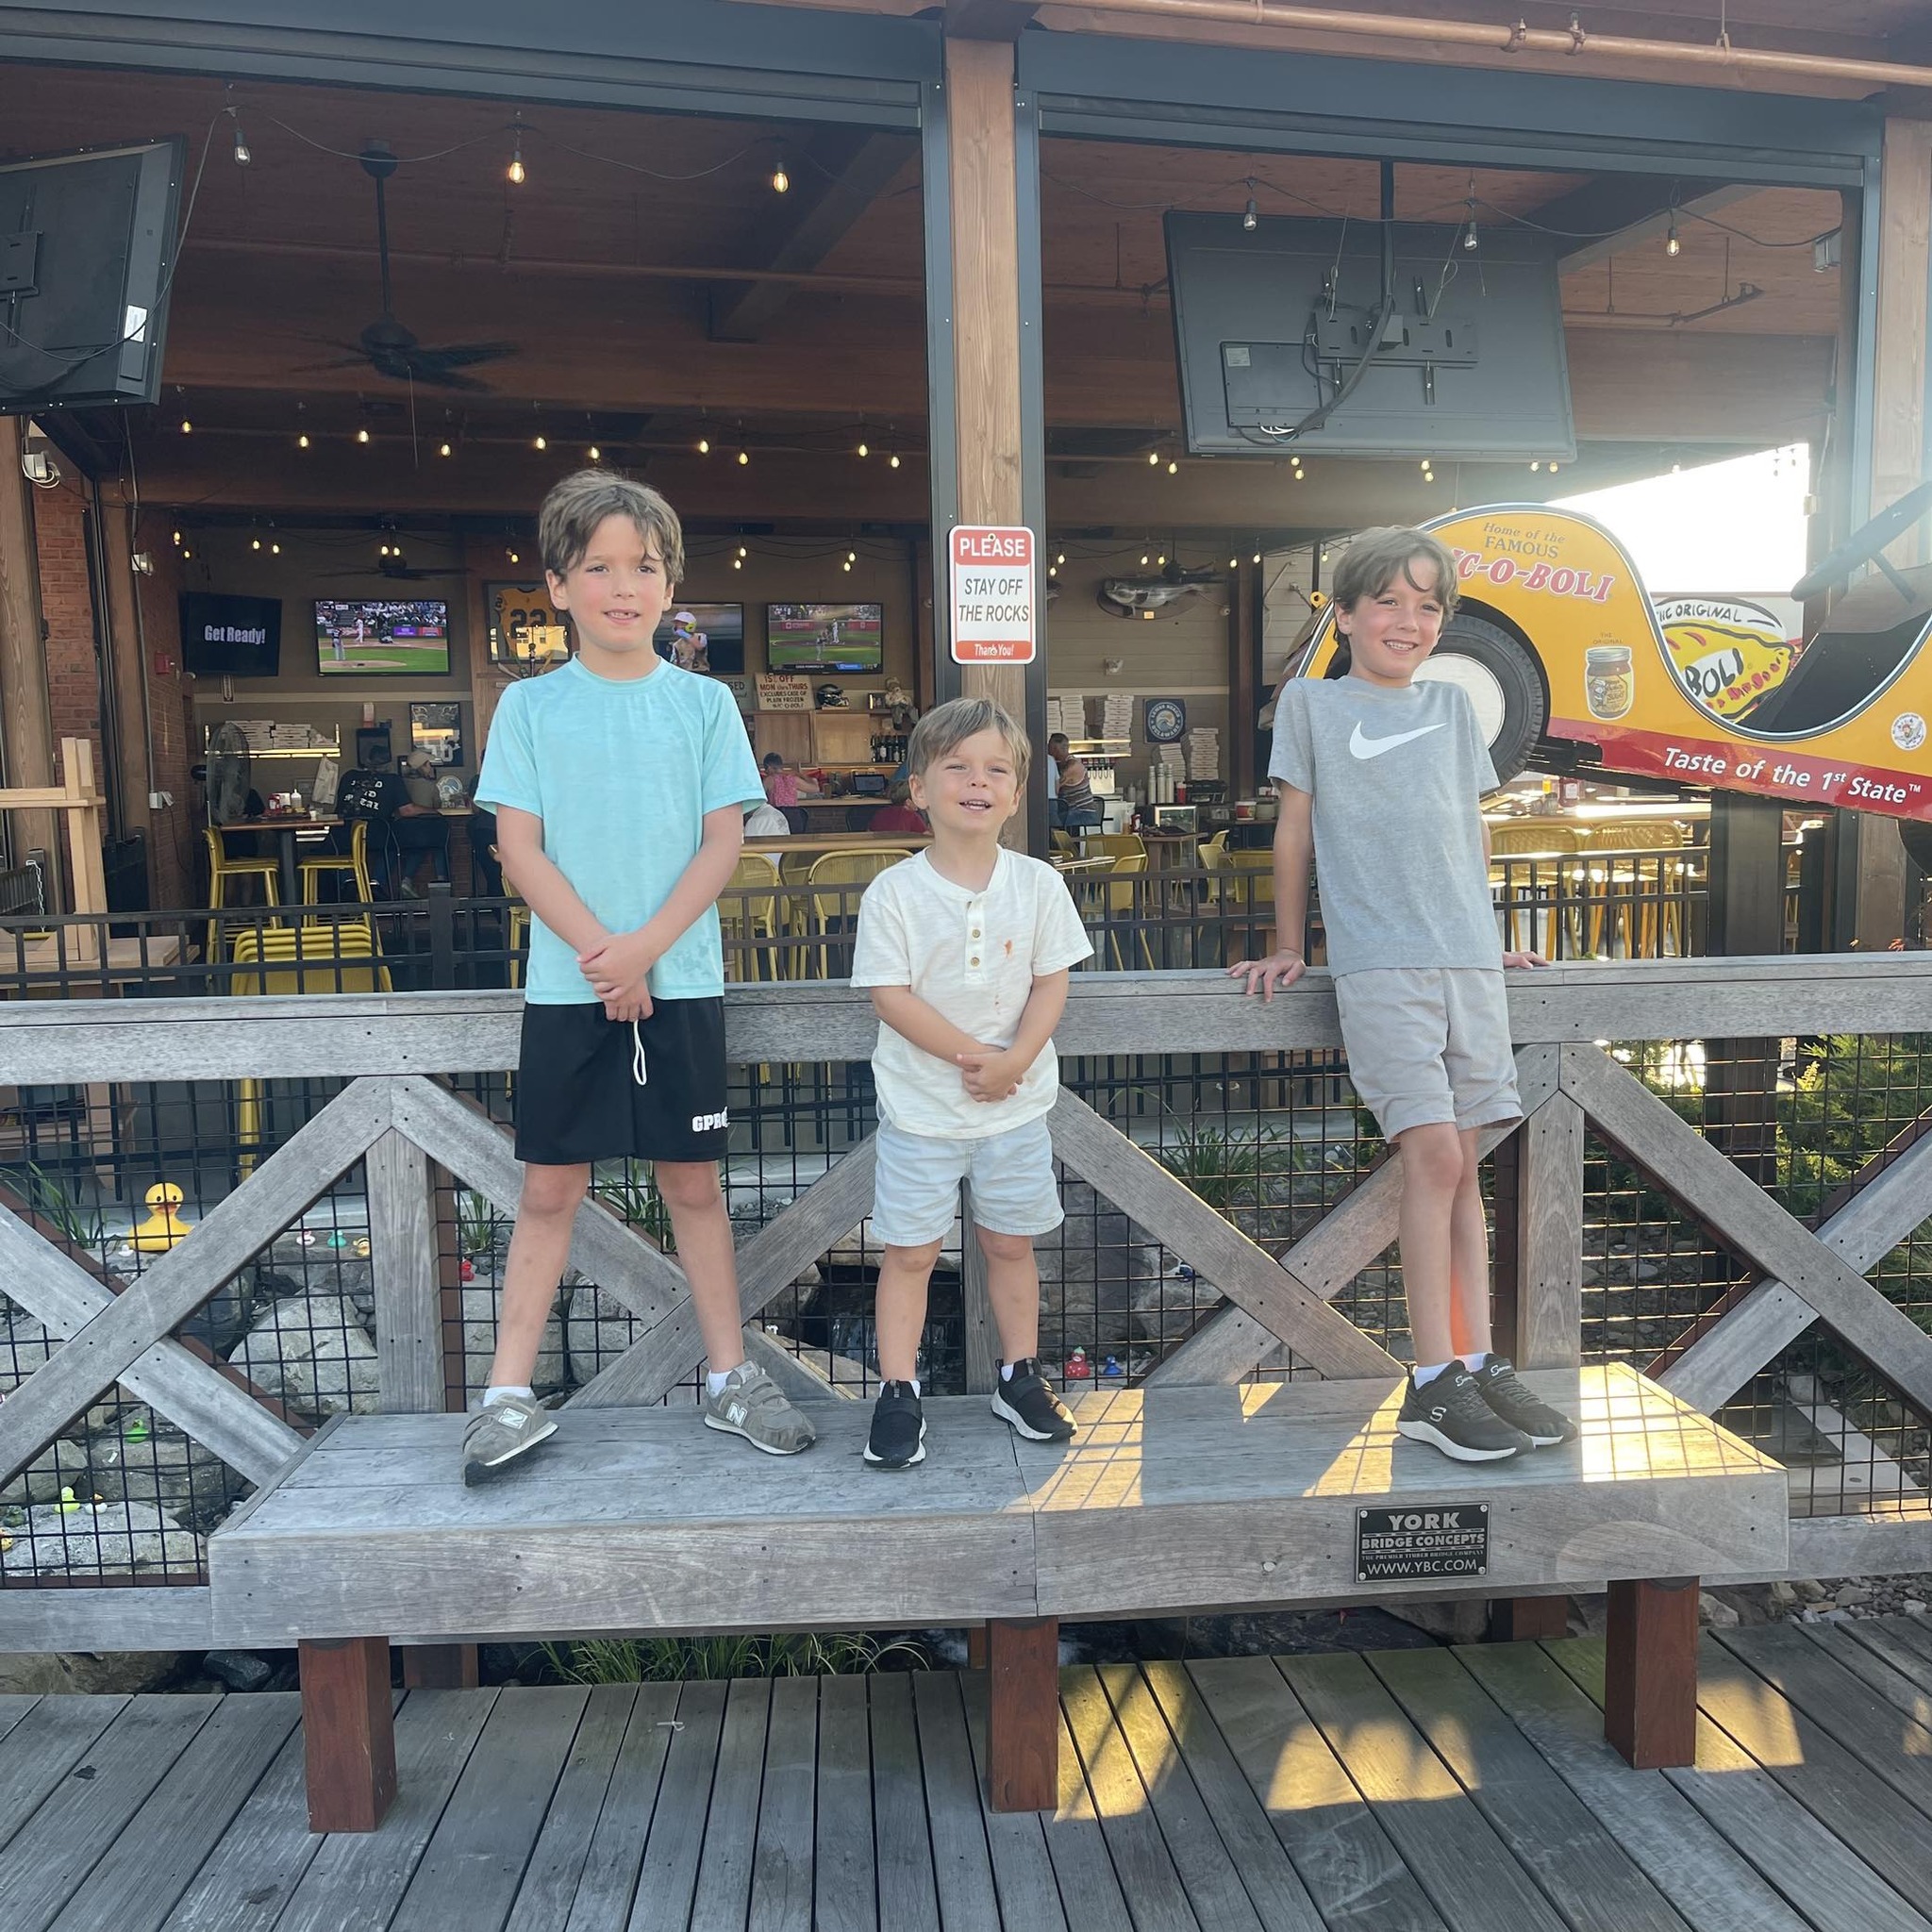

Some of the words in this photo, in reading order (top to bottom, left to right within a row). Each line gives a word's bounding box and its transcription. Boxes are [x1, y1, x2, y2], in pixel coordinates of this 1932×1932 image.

[1483, 522, 1521, 537] Home
[1525, 529, 1541, 540] of
[1544, 531, 1566, 544] the
[959, 536, 1026, 558] PLEASE
[1485, 536, 1558, 558] FAMOUS
[1453, 549, 1615, 603] C-O-BOLI
[964, 577, 996, 595] STAY
[998, 578, 1023, 595] OFF
[958, 605, 983, 622] THE
[986, 605, 1029, 622] ROCKS
[1657, 607, 1673, 623] HE
[1675, 604, 1742, 624] ORIGINAL
[205, 625, 225, 641] Get
[226, 626, 266, 644] Ready!
[998, 644, 1014, 656] You!
[779, 675, 794, 683] OFF
[1685, 648, 1744, 698] BOLI
[727, 681, 745, 691] SED
[1664, 747, 1727, 774] Taste
[1735, 759, 1767, 780] of
[1773, 765, 1810, 788] the
[1822, 772, 1846, 791] 1st
[725, 1402, 748, 1428] N
[1429, 1407, 1446, 1423] S
[1388, 1512, 1460, 1531] YORK
[1361, 1537, 1413, 1549] BRIDGE
[1415, 1534, 1485, 1547] CONCEPTS
[1367, 1558, 1477, 1575] WWW.YBC.COM
